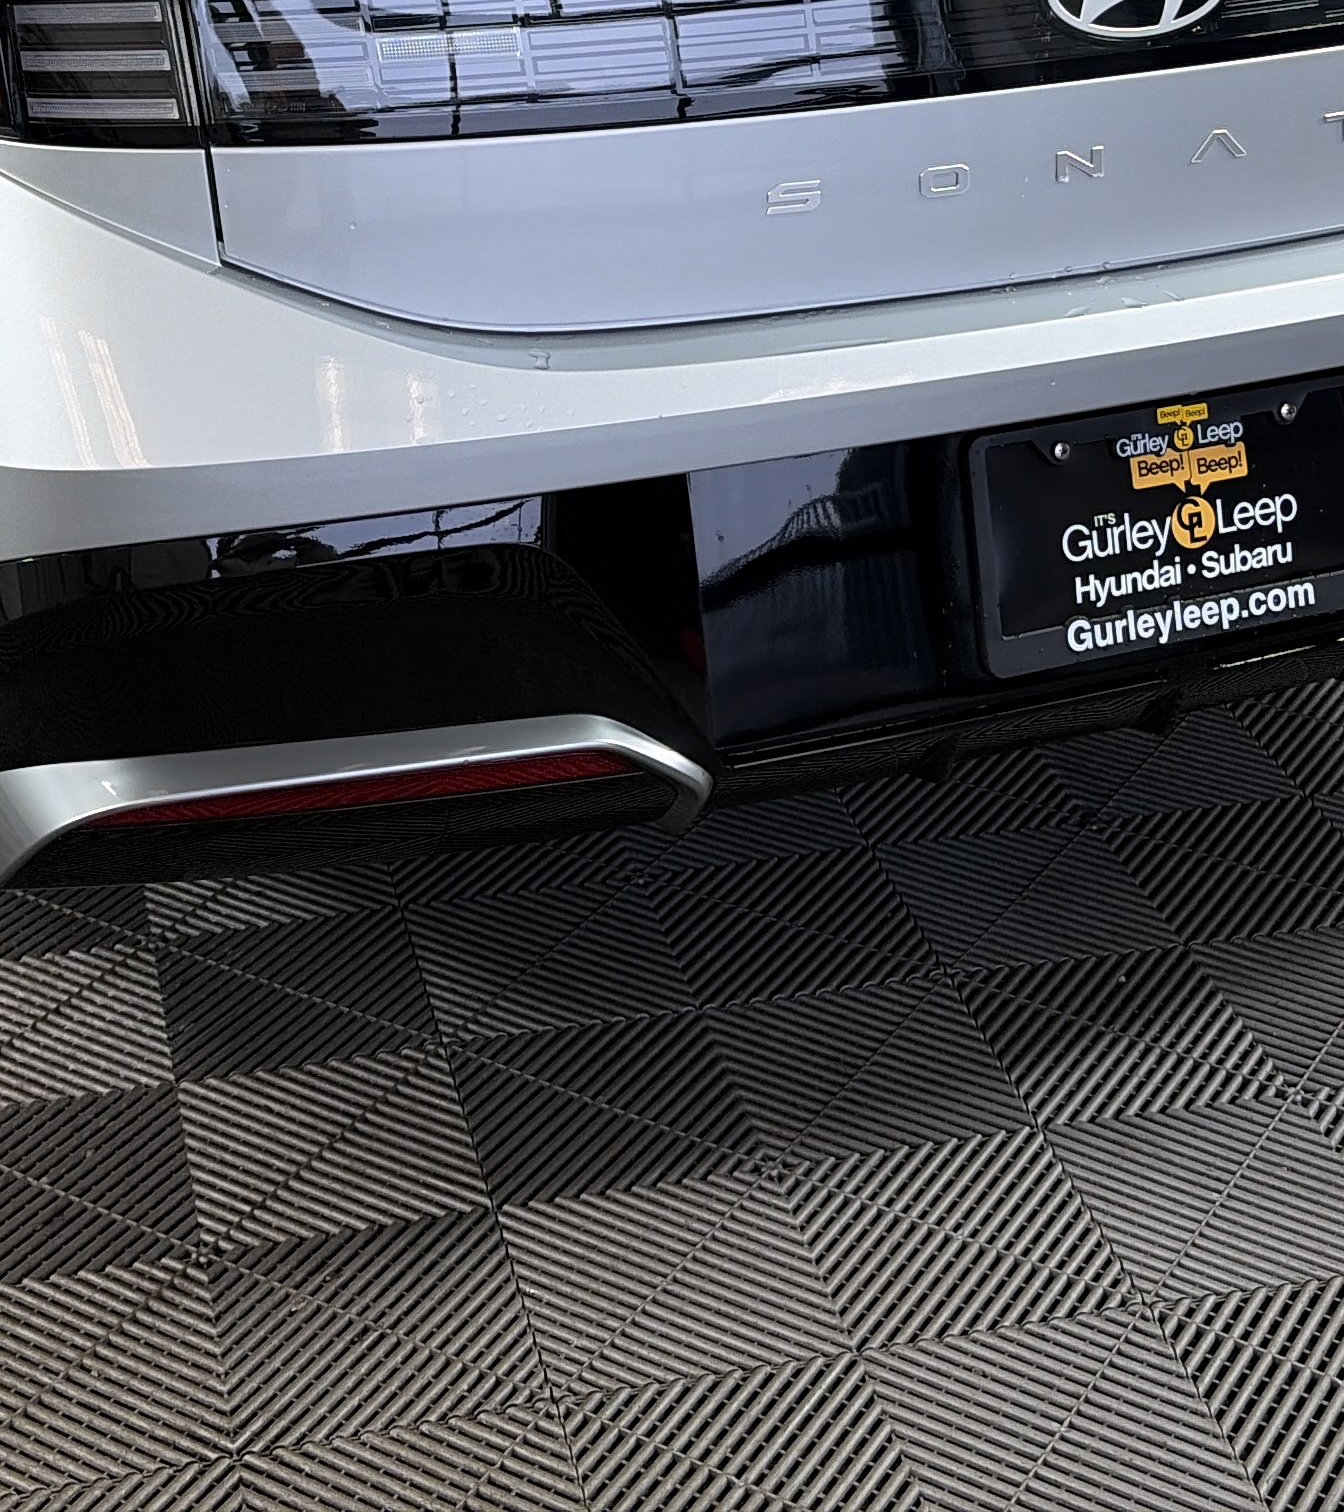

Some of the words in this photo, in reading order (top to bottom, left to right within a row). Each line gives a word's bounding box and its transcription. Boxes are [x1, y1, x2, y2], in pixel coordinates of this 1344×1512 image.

[1116, 433, 1169, 457] Gurley
[1197, 421, 1244, 444] Leep
[1137, 453, 1185, 477] Beep!
[1196, 450, 1243, 474] Beep!
[1062, 512, 1172, 562] Gurley
[1215, 493, 1298, 533] Leep
[1075, 555, 1182, 607] Hyundai
[1201, 541, 1293, 579] Subaru
[1066, 581, 1316, 652] Gurleyleep.com
